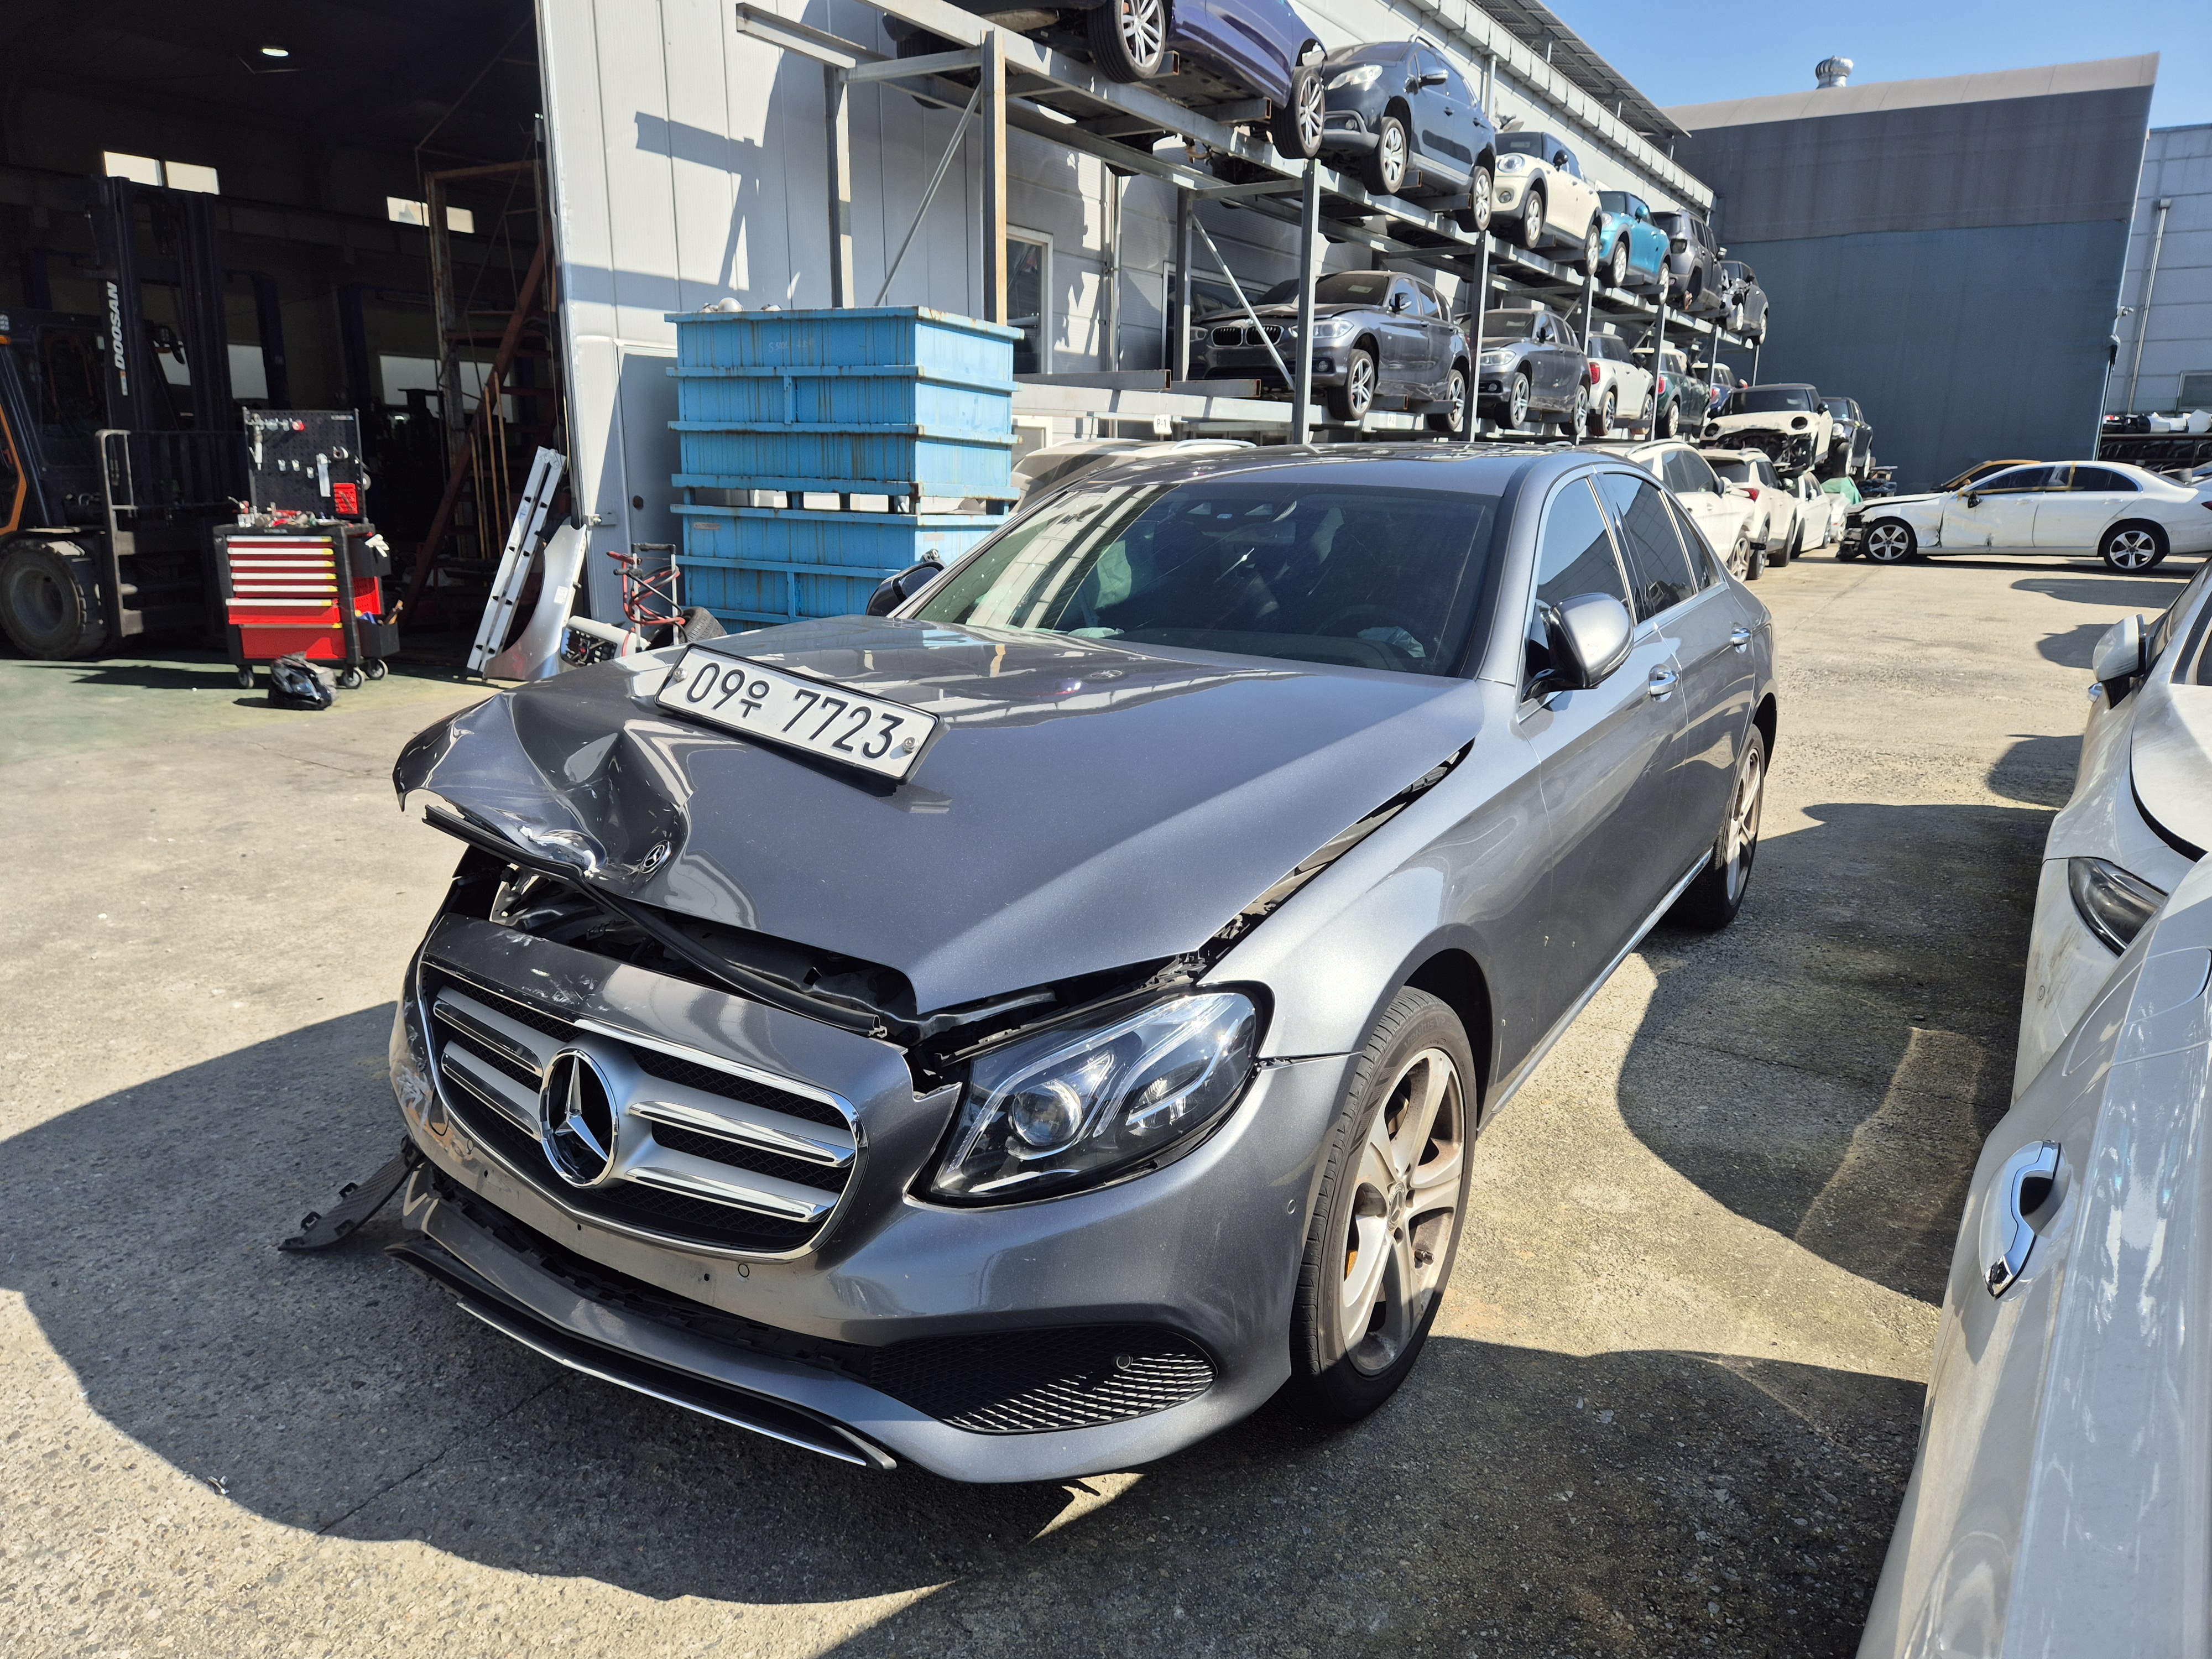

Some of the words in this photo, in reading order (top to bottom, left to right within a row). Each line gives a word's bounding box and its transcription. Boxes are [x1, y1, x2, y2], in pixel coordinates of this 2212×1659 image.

[107, 281, 126, 371] DOOSAN
[1157, 418, 1167, 428] P-1
[686, 662, 770, 718] 09우
[781, 688, 905, 759] 7723
